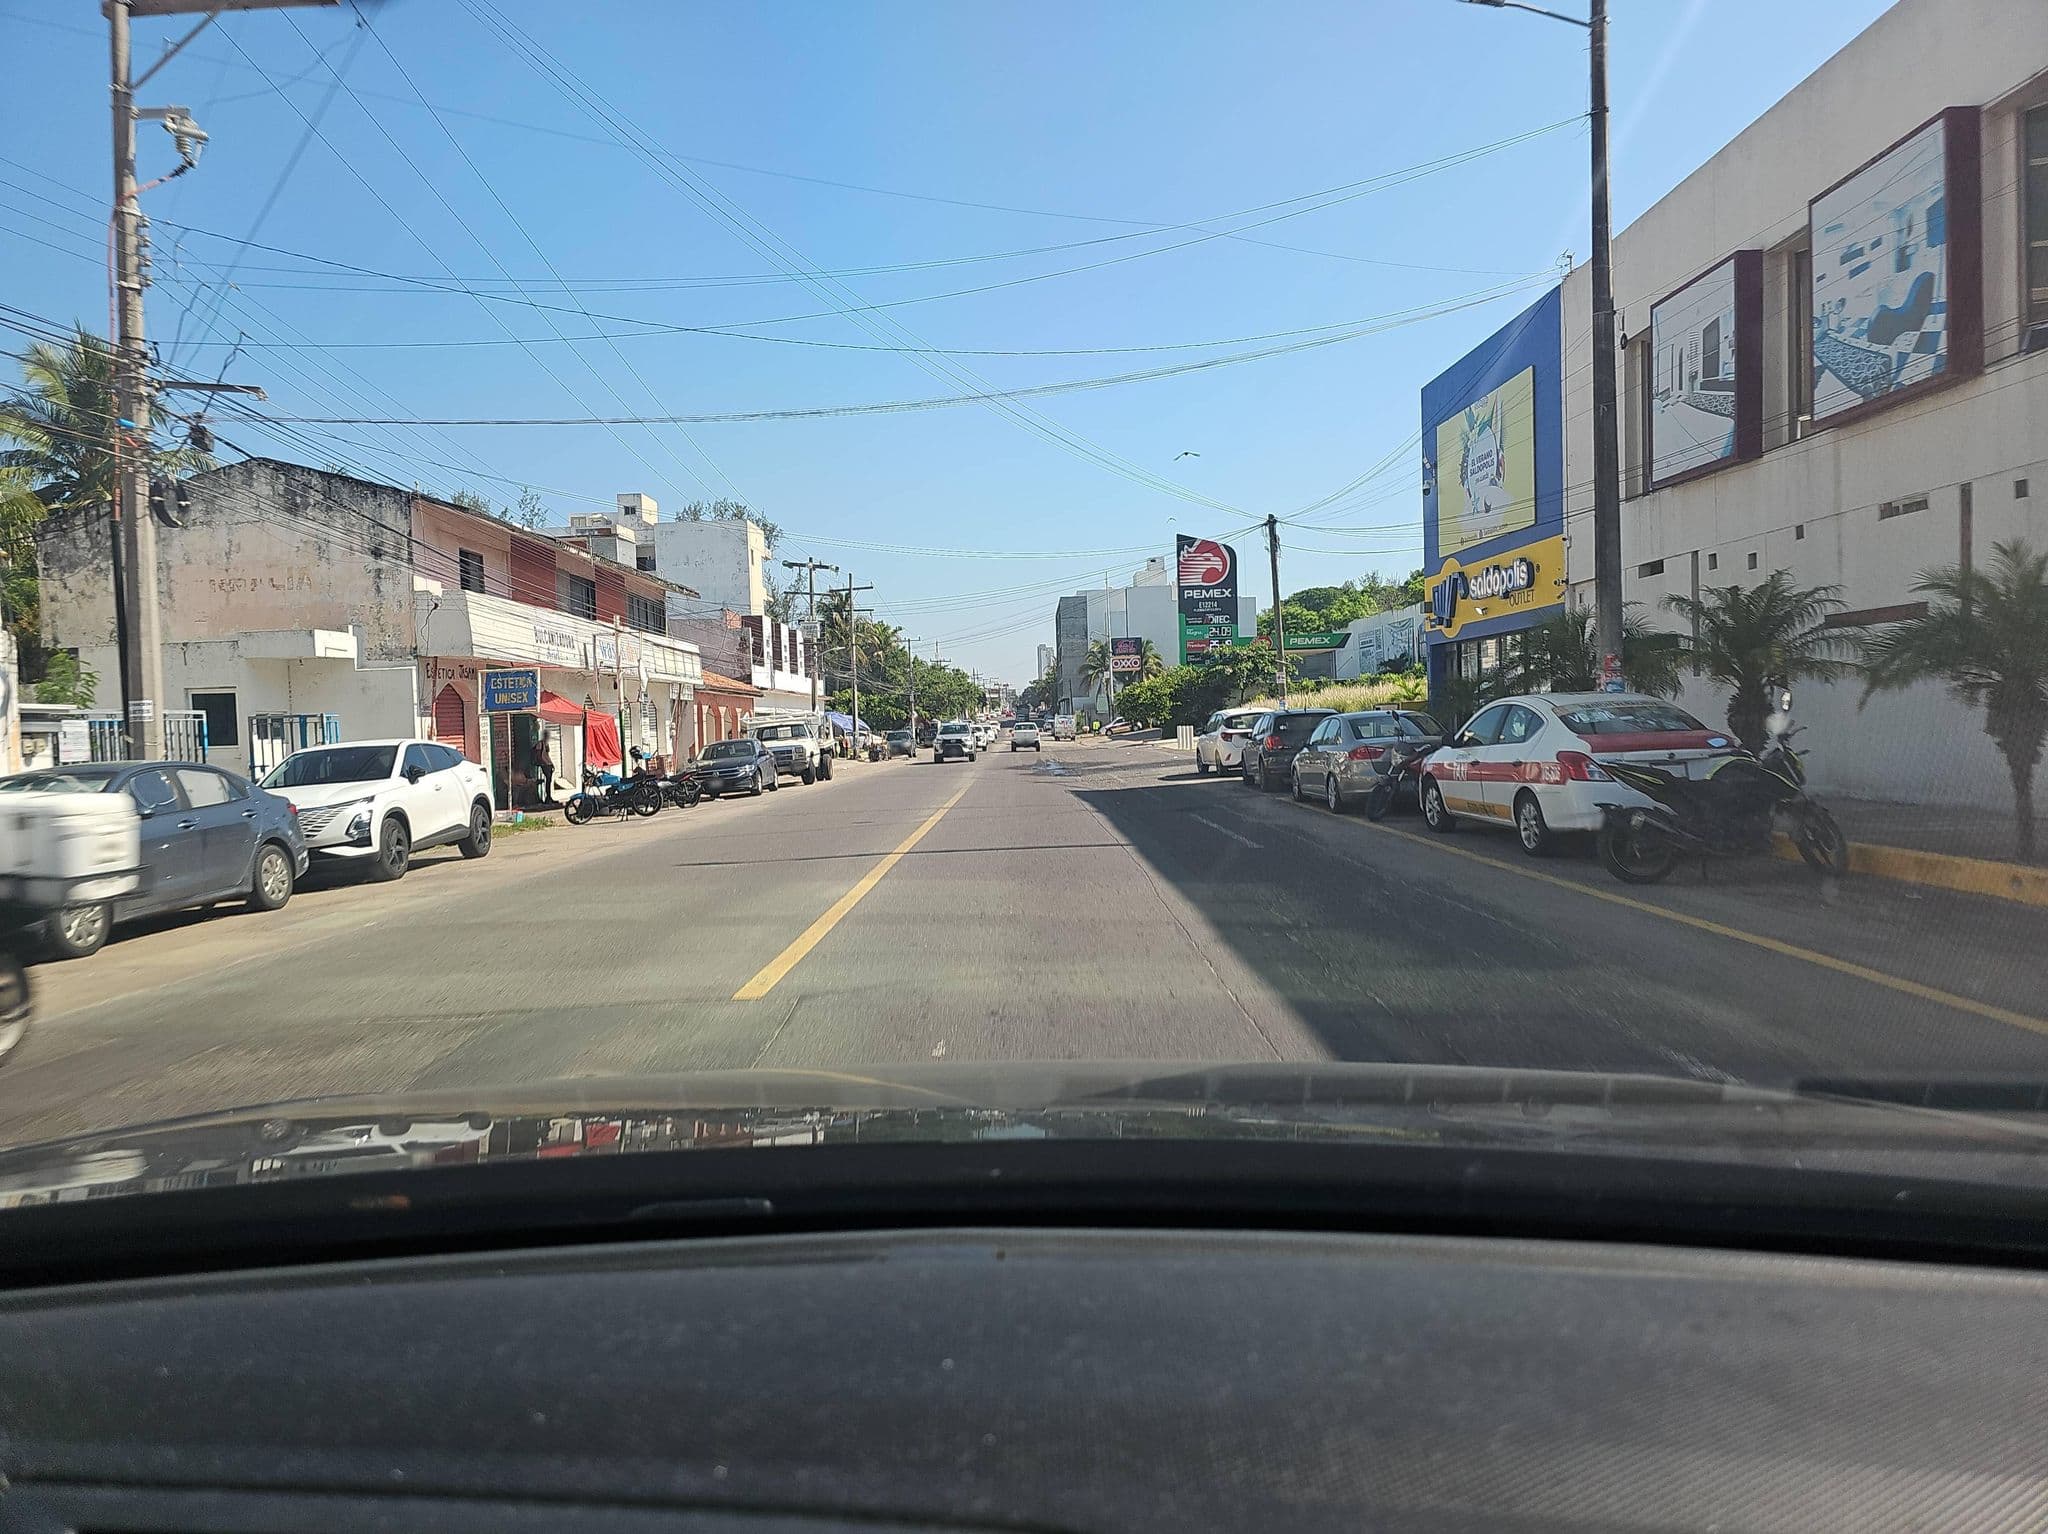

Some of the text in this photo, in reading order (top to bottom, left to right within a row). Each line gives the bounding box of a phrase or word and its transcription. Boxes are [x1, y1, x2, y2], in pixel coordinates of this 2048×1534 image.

[1476, 449, 1493, 465] VERANO
[1183, 588, 1232, 600] PEMEX
[1509, 588, 1535, 607] OUTLET
[1289, 636, 1331, 646] PEMEX
[1112, 656, 1140, 669] OXXO
[425, 661, 455, 680] ESETICA
[494, 691, 529, 704] UNISEX
